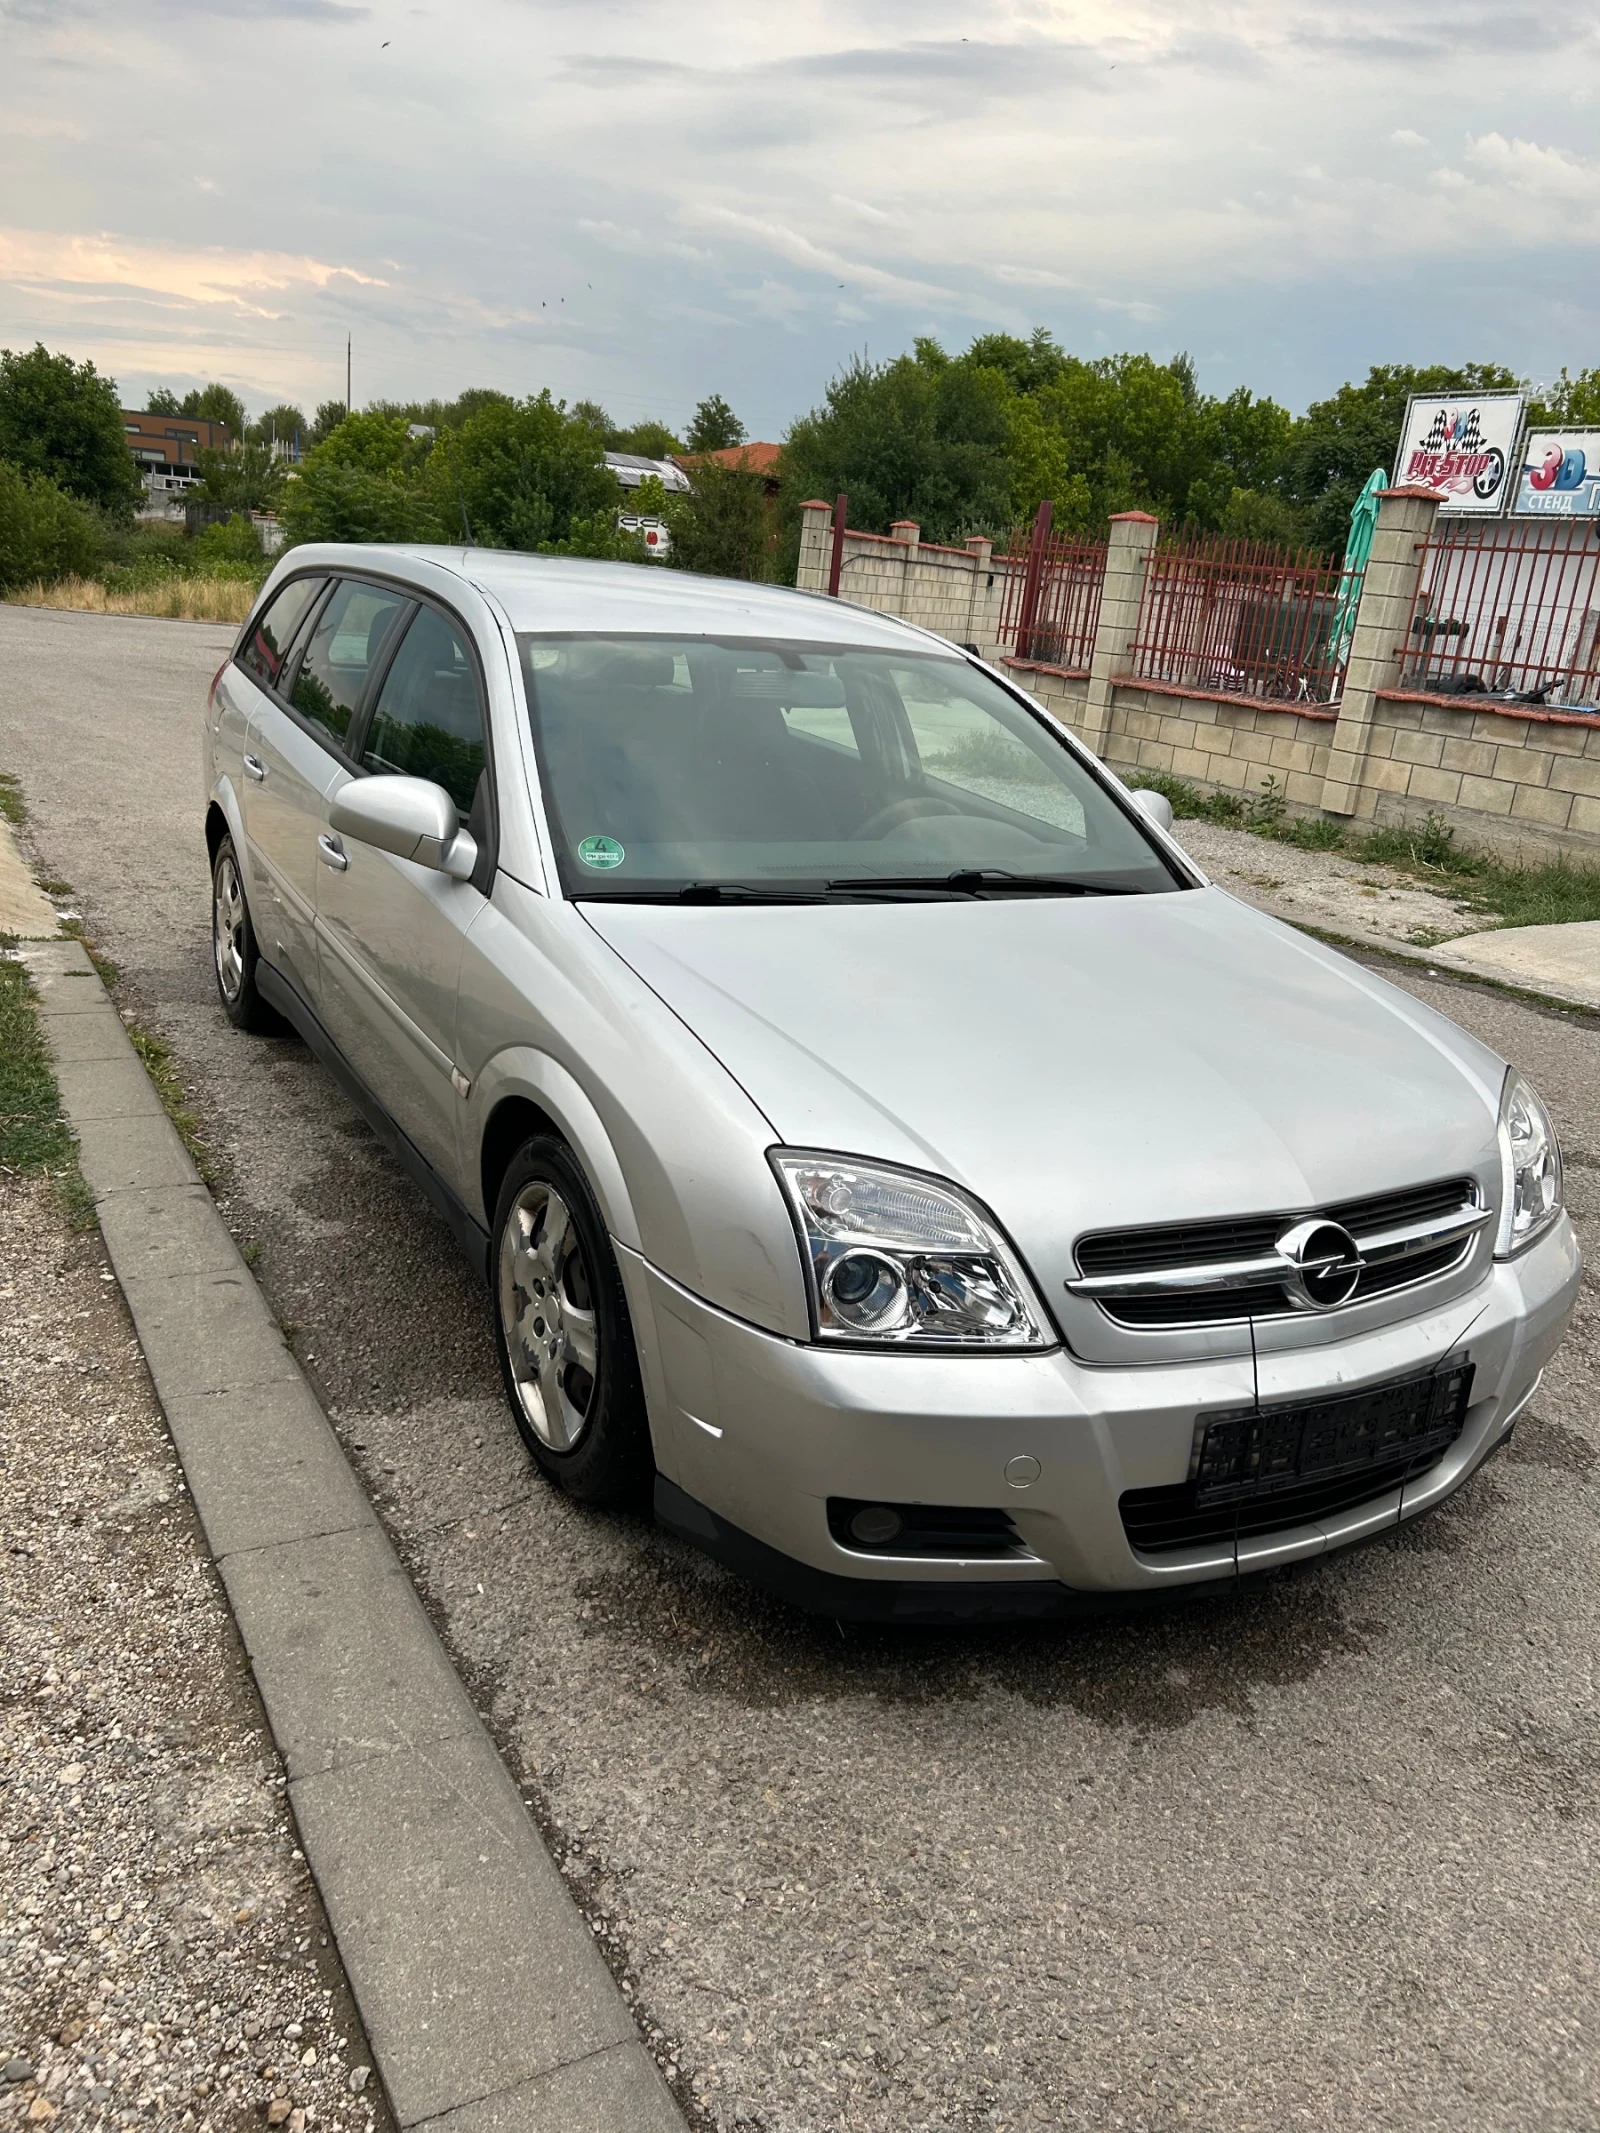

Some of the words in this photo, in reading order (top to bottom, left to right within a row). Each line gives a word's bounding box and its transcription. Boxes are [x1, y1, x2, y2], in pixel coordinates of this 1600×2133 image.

[1444, 408, 1468, 440] 3D
[1530, 443, 1587, 491] 3D
[1528, 495, 1573, 512] СТЕНД
[595, 838, 607, 852] 4
